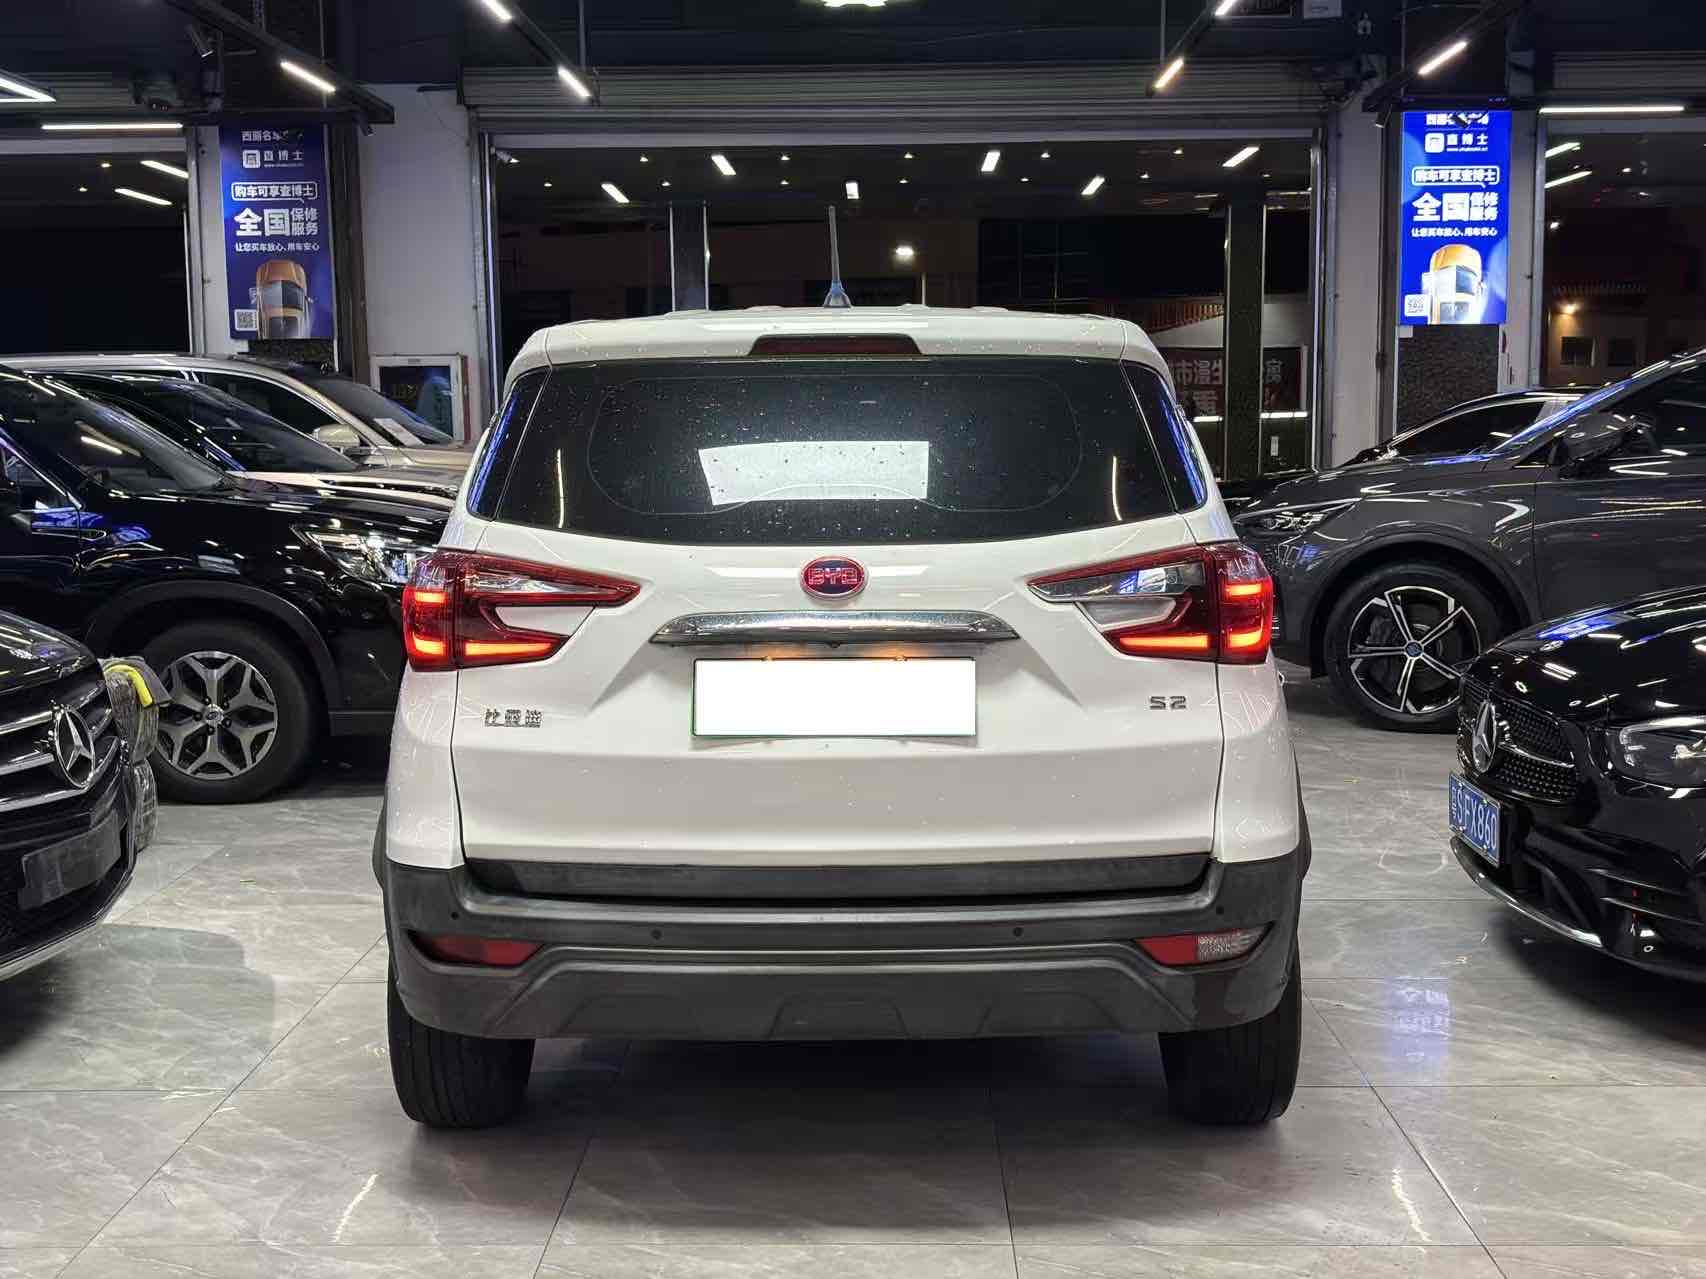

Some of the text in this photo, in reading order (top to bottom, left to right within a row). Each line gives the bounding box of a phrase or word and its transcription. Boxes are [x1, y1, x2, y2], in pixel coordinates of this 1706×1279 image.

[1415, 169, 1496, 183] 购车可享查博士
[235, 185, 315, 198] 购车可享查博士
[1470, 192, 1498, 206] 保修
[1412, 192, 1469, 221] 全国
[234, 208, 290, 236] 全国
[291, 208, 318, 222] 保修
[291, 223, 318, 236] 服务
[808, 567, 858, 585] BYD
[1150, 695, 1186, 710] S2
